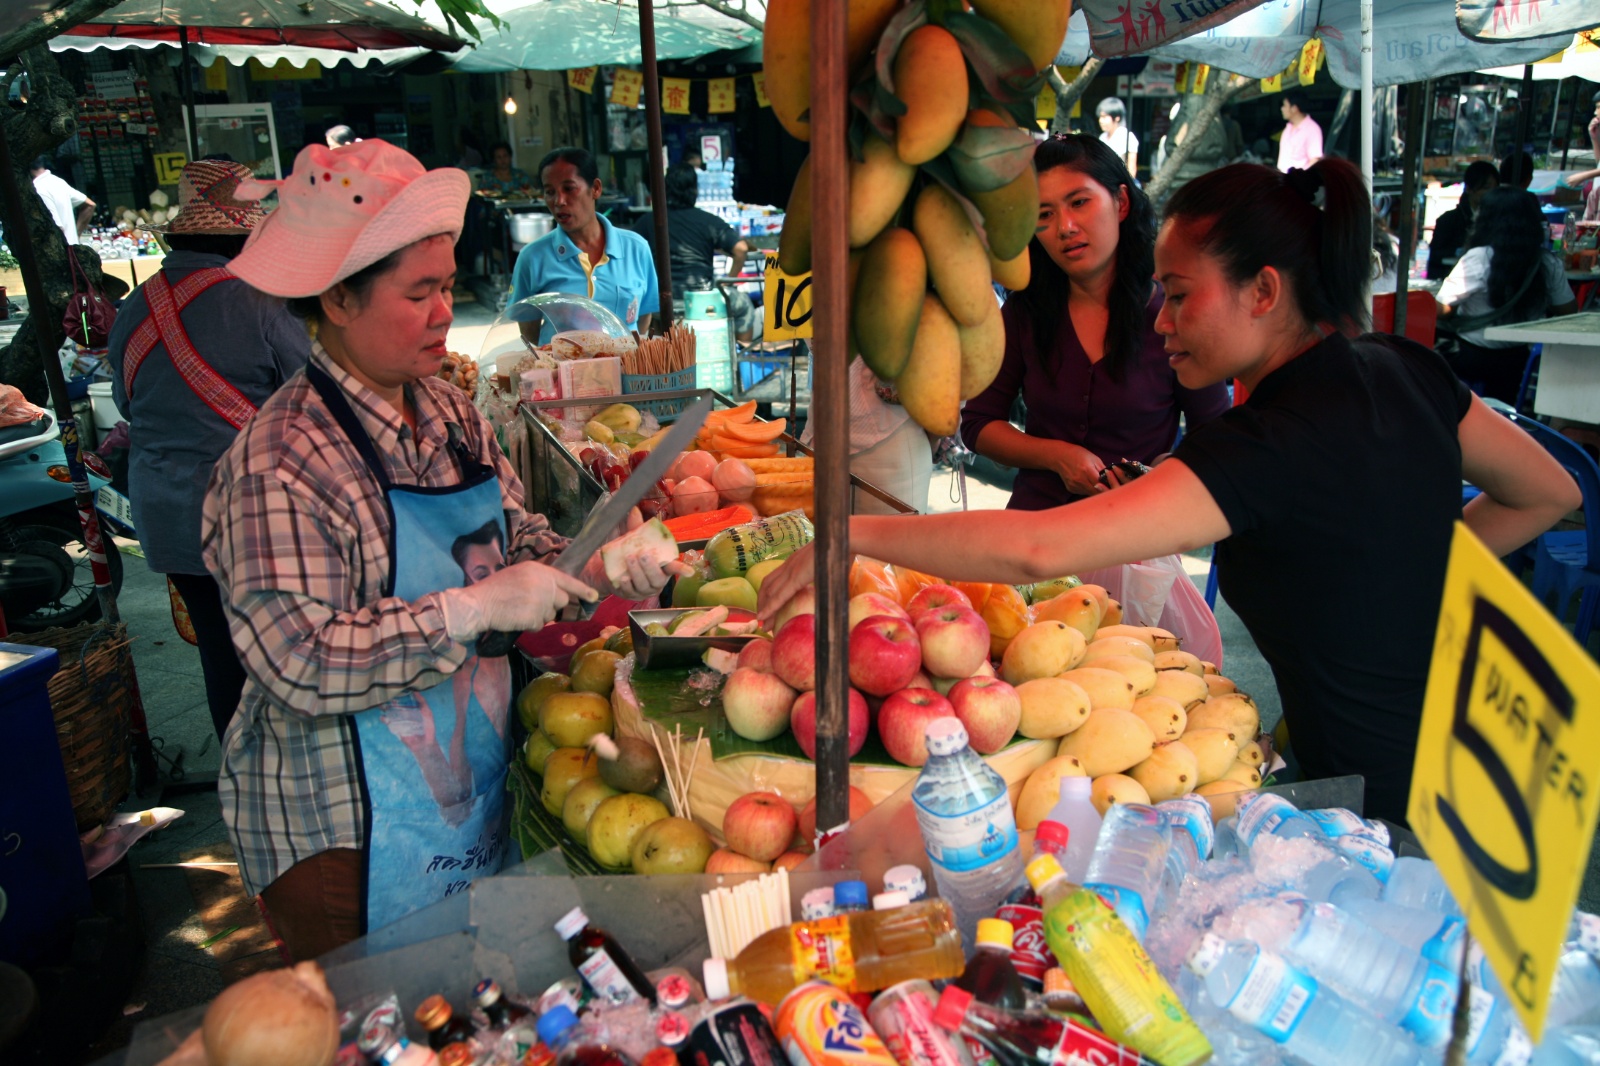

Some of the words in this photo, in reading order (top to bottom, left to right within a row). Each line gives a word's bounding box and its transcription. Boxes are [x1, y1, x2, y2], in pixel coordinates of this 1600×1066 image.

[157, 155, 185, 181] 15
[702, 137, 720, 161] 5
[773, 276, 813, 330] 10
[1434, 590, 1578, 903] 5
[1482, 661, 1587, 827] WATER
